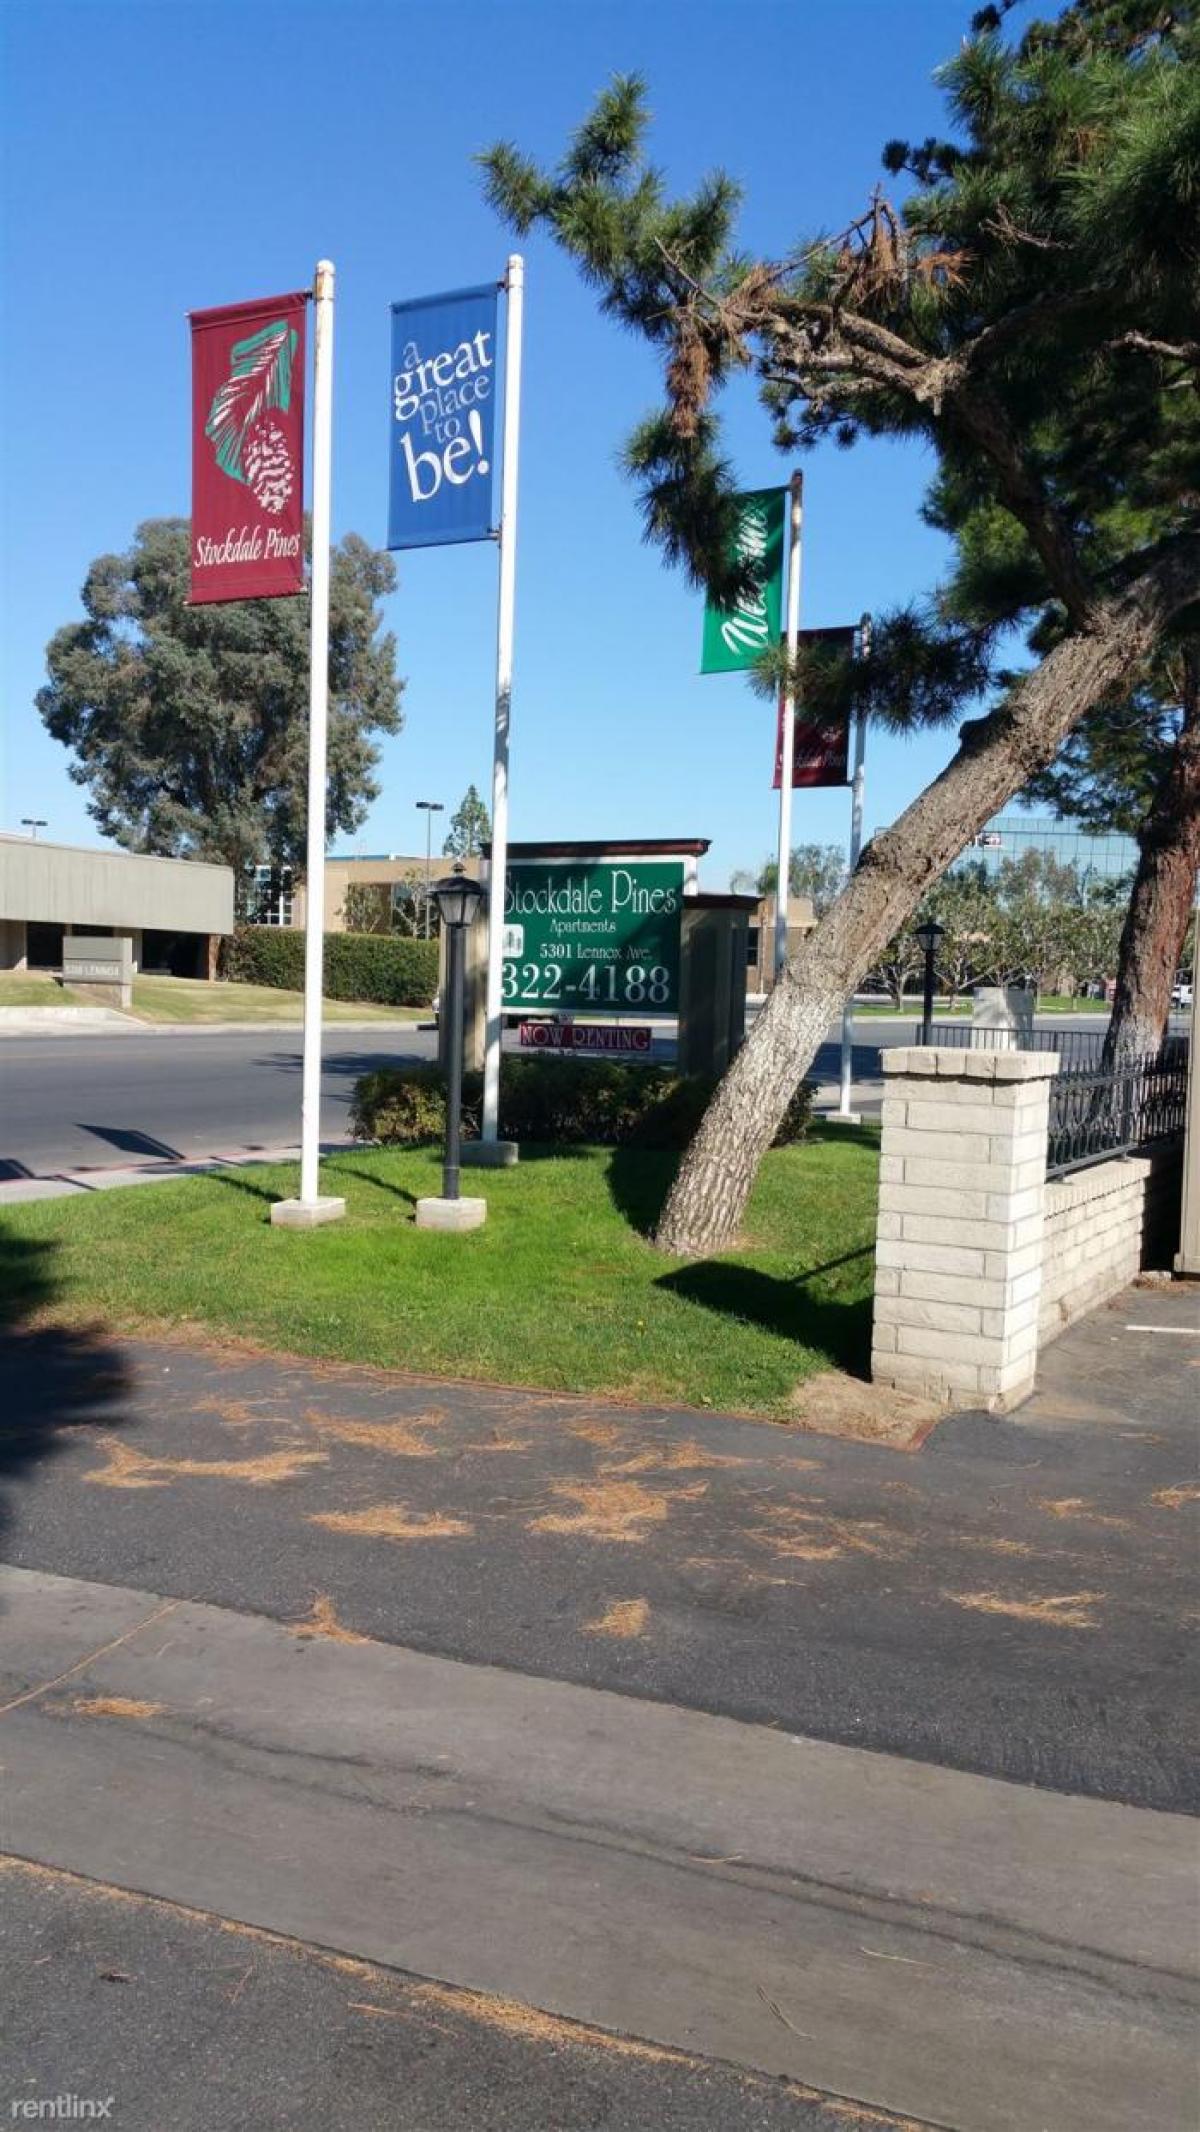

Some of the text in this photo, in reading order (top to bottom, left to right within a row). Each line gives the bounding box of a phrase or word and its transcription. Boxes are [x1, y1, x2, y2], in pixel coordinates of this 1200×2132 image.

[394, 329, 493, 421] great
[403, 341, 422, 369] a
[420, 374, 491, 435] place
[435, 417, 461, 444] to
[400, 409, 490, 502] be!
[194, 525, 300, 568] Stockdale Pines
[503, 869, 677, 915] Stockdale Pines
[550, 918, 616, 937] Apartments
[539, 943, 572, 959] 5301
[577, 943, 621, 959] Lennox
[502, 962, 670, 1004] 322-4188
[521, 1025, 649, 1050] NOW RENTING
